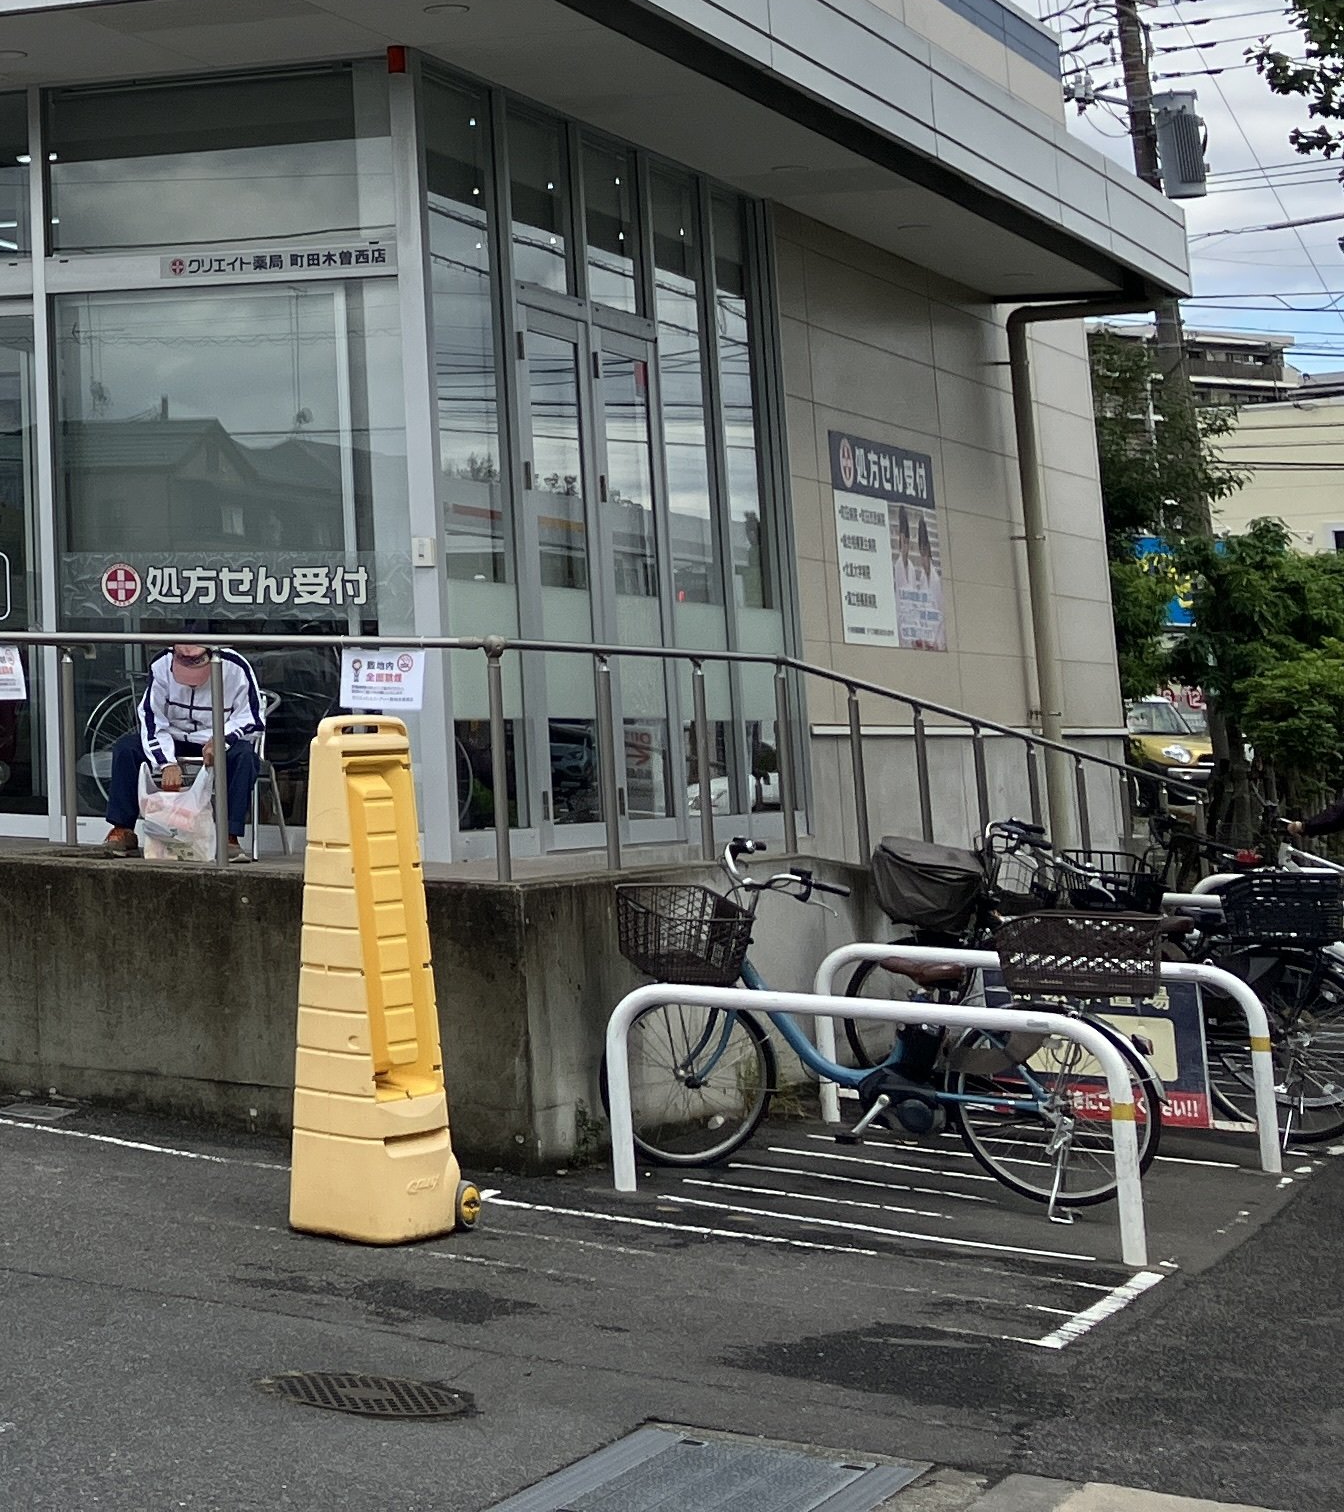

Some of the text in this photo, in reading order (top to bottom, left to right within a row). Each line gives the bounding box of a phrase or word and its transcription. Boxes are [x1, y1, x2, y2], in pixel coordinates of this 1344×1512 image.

[188, 254, 283, 274] クリエイト薬局
[854, 445, 928, 500] 処方せん受付
[145, 565, 369, 606] 処方せん受付
